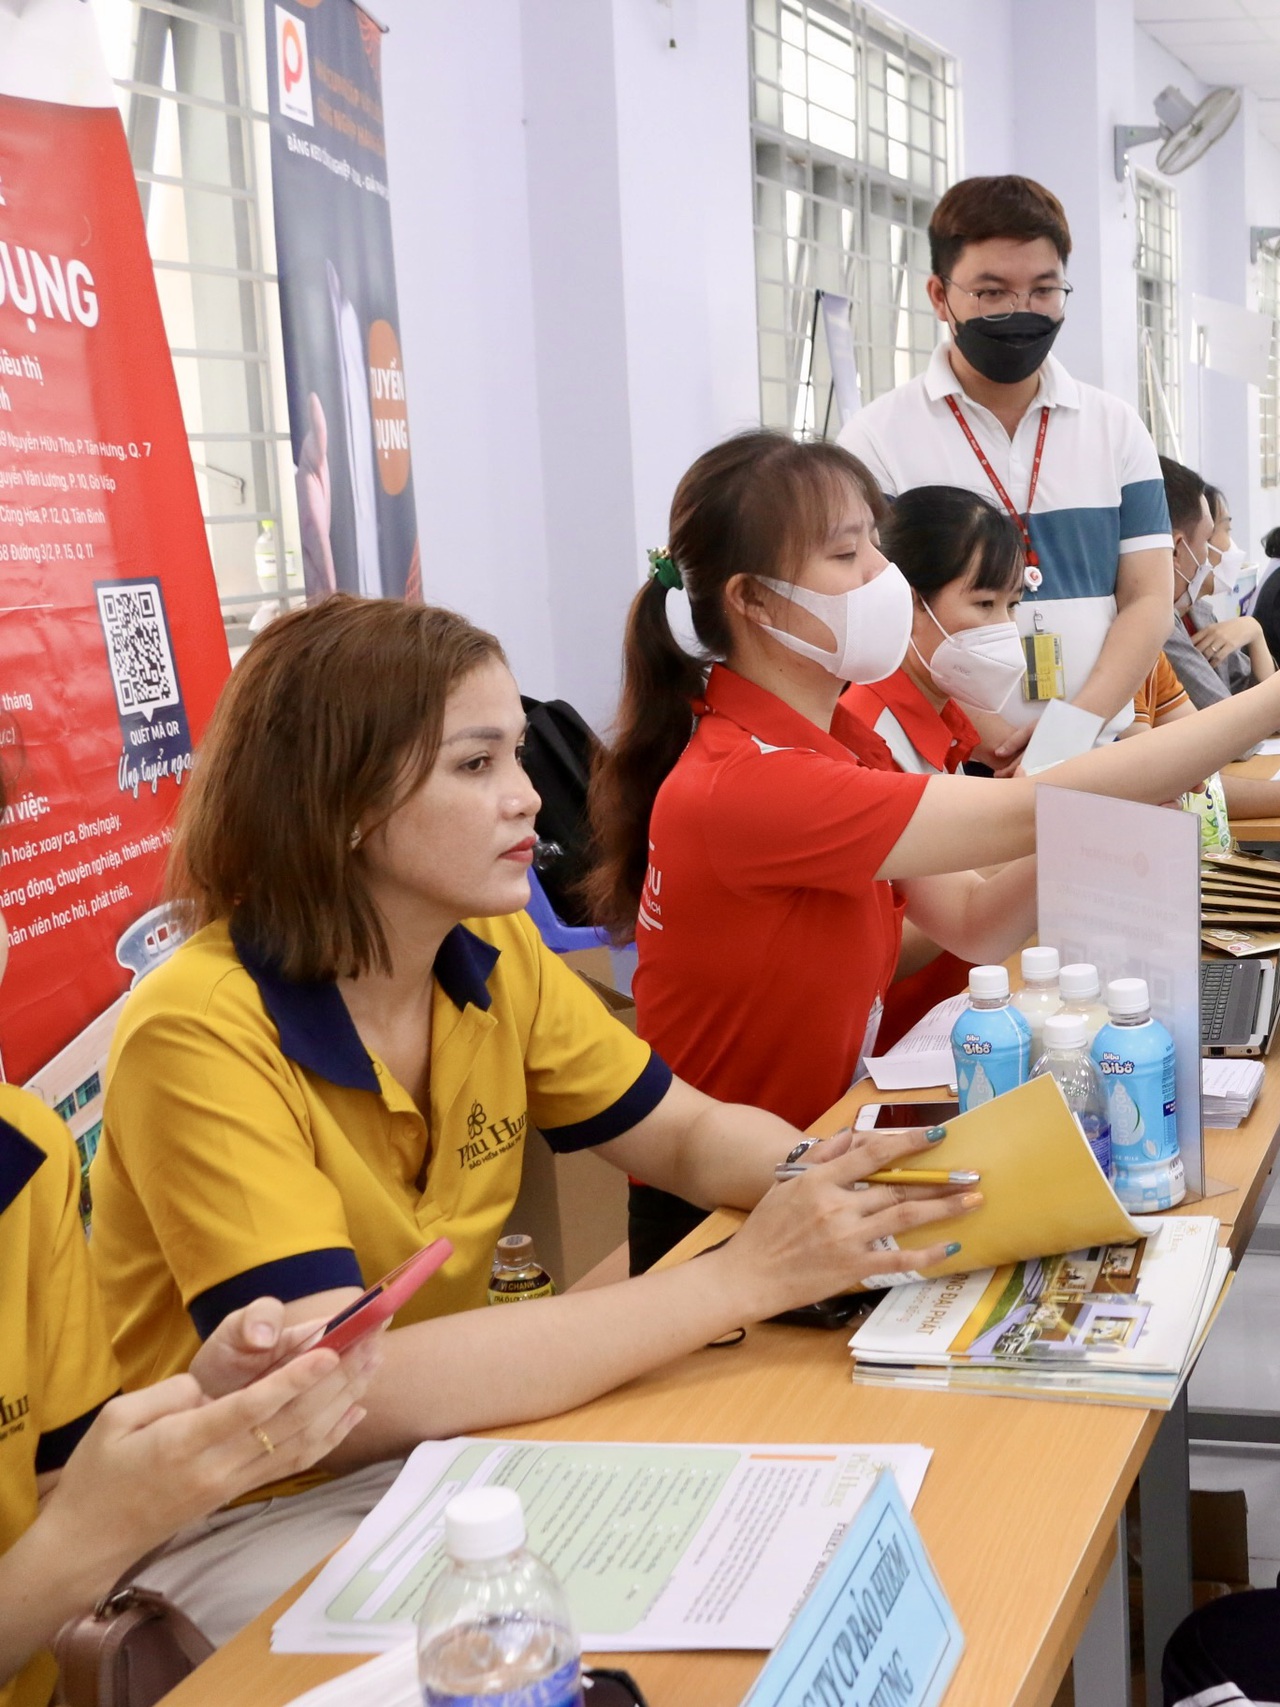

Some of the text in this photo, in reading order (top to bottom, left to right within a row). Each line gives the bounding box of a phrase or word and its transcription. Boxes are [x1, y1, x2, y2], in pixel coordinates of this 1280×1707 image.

[0, 241, 99, 333] ỤNG
[21, 354, 44, 387] thị
[128, 443, 142, 459] Q.
[143, 442, 152, 457] 7
[0, 466, 23, 488] guyễn
[85, 543, 94, 558] 11
[3, 692, 32, 711] tháng
[166, 721, 180, 738] QR
[17, 792, 51, 823] việc:
[11, 840, 39, 867] hoặc
[40, 834, 63, 854] xoay
[63, 827, 78, 846] ca,
[78, 813, 122, 841] 8hrs/ngày.
[27, 876, 57, 901] động,
[57, 859, 92, 889] chuyên
[91, 851, 124, 878] nghiệp,
[121, 842, 141, 863] thân
[29, 915, 51, 940] viên
[51, 909, 71, 933] học
[72, 898, 91, 920] hỏi,
[91, 889, 110, 918] phát
[109, 880, 133, 902] triển.
[832, 1630, 859, 1689] CP
[846, 1588, 883, 1663] BẢO
